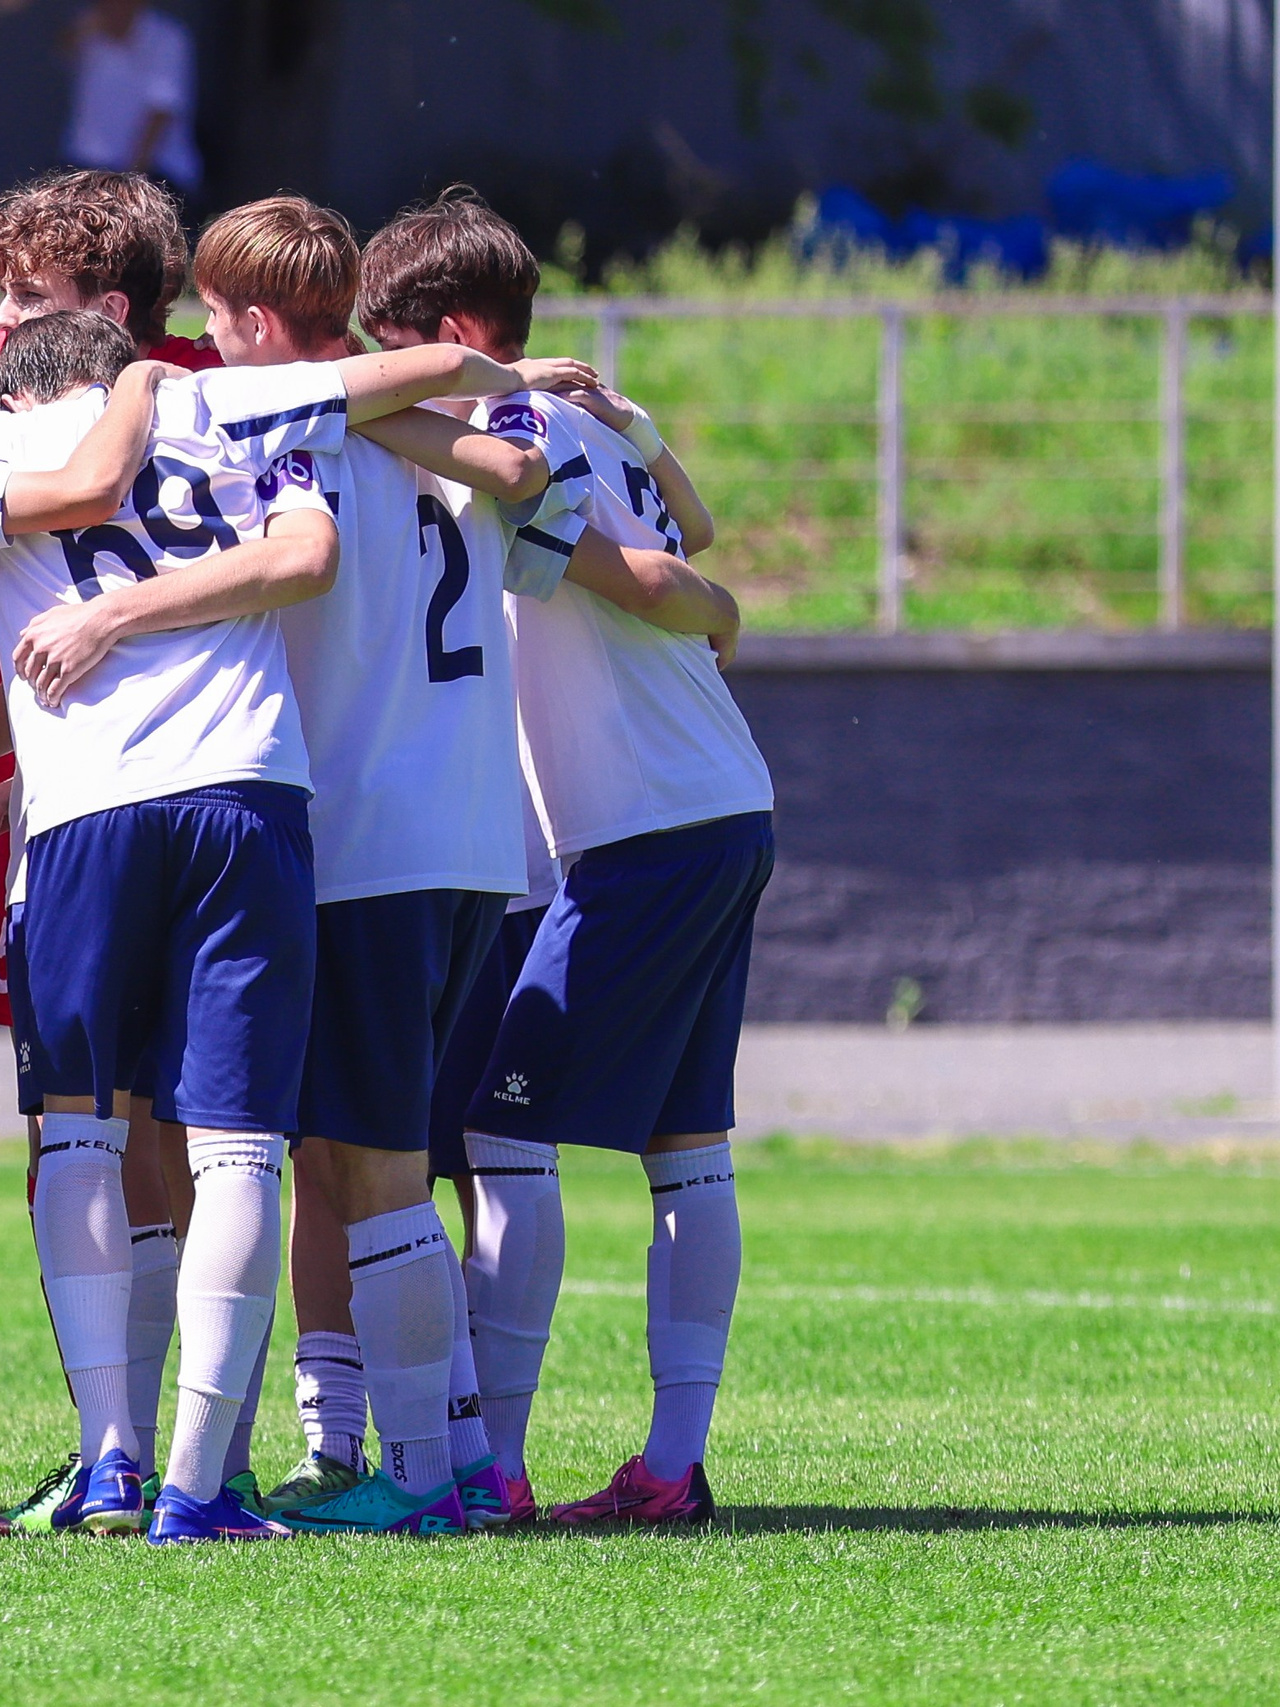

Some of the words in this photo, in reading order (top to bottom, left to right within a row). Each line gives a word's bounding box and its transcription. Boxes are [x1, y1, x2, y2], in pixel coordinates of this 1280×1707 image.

[418, 494, 483, 683] 2
[494, 1090, 531, 1105] KELME
[203, 1160, 276, 1174] KELME
